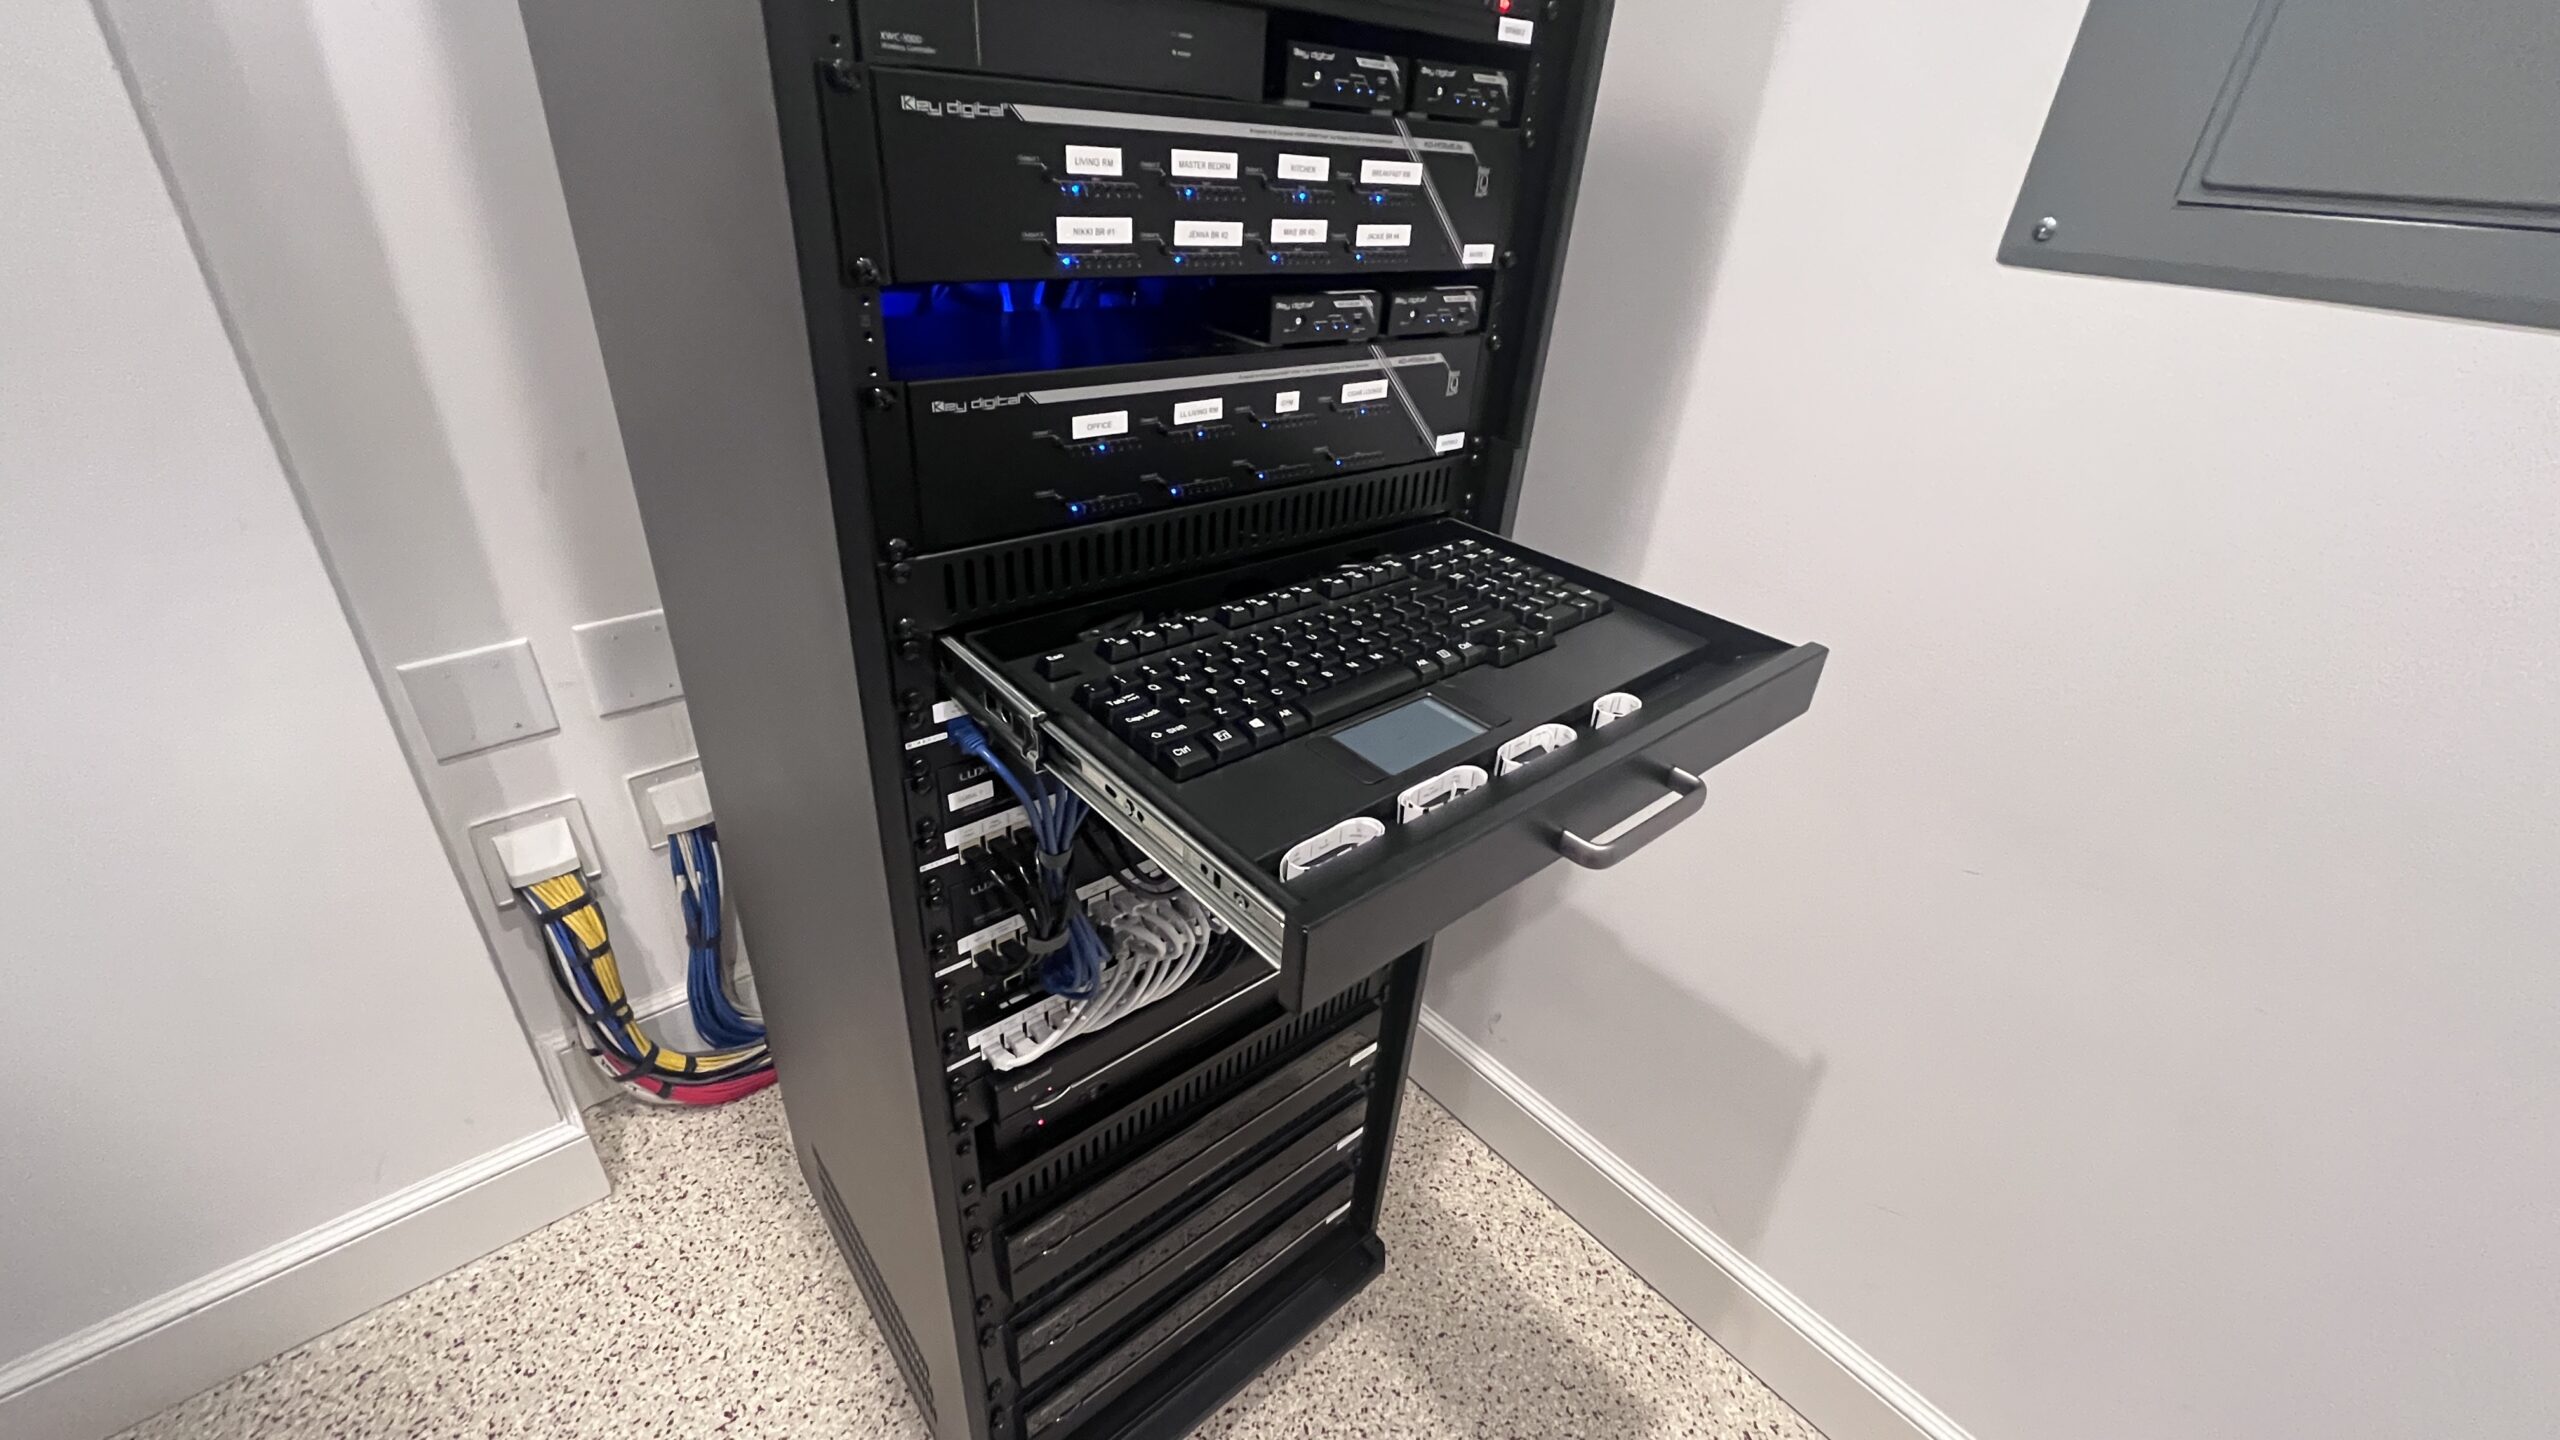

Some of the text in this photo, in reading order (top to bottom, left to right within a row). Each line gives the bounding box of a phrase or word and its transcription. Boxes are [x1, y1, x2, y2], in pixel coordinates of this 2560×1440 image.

[900, 95, 1005, 119] Key digital
[1074, 157, 1114, 168] LIVING RM
[1178, 160, 1231, 171] MASTER BEDRM
[1072, 227, 1096, 236] NIKKI
[1097, 227, 1106, 236] BR
[931, 394, 1021, 413] Key digital
[1086, 420, 1112, 431] OFFICE
[1172, 745, 1192, 757] Ctrl
